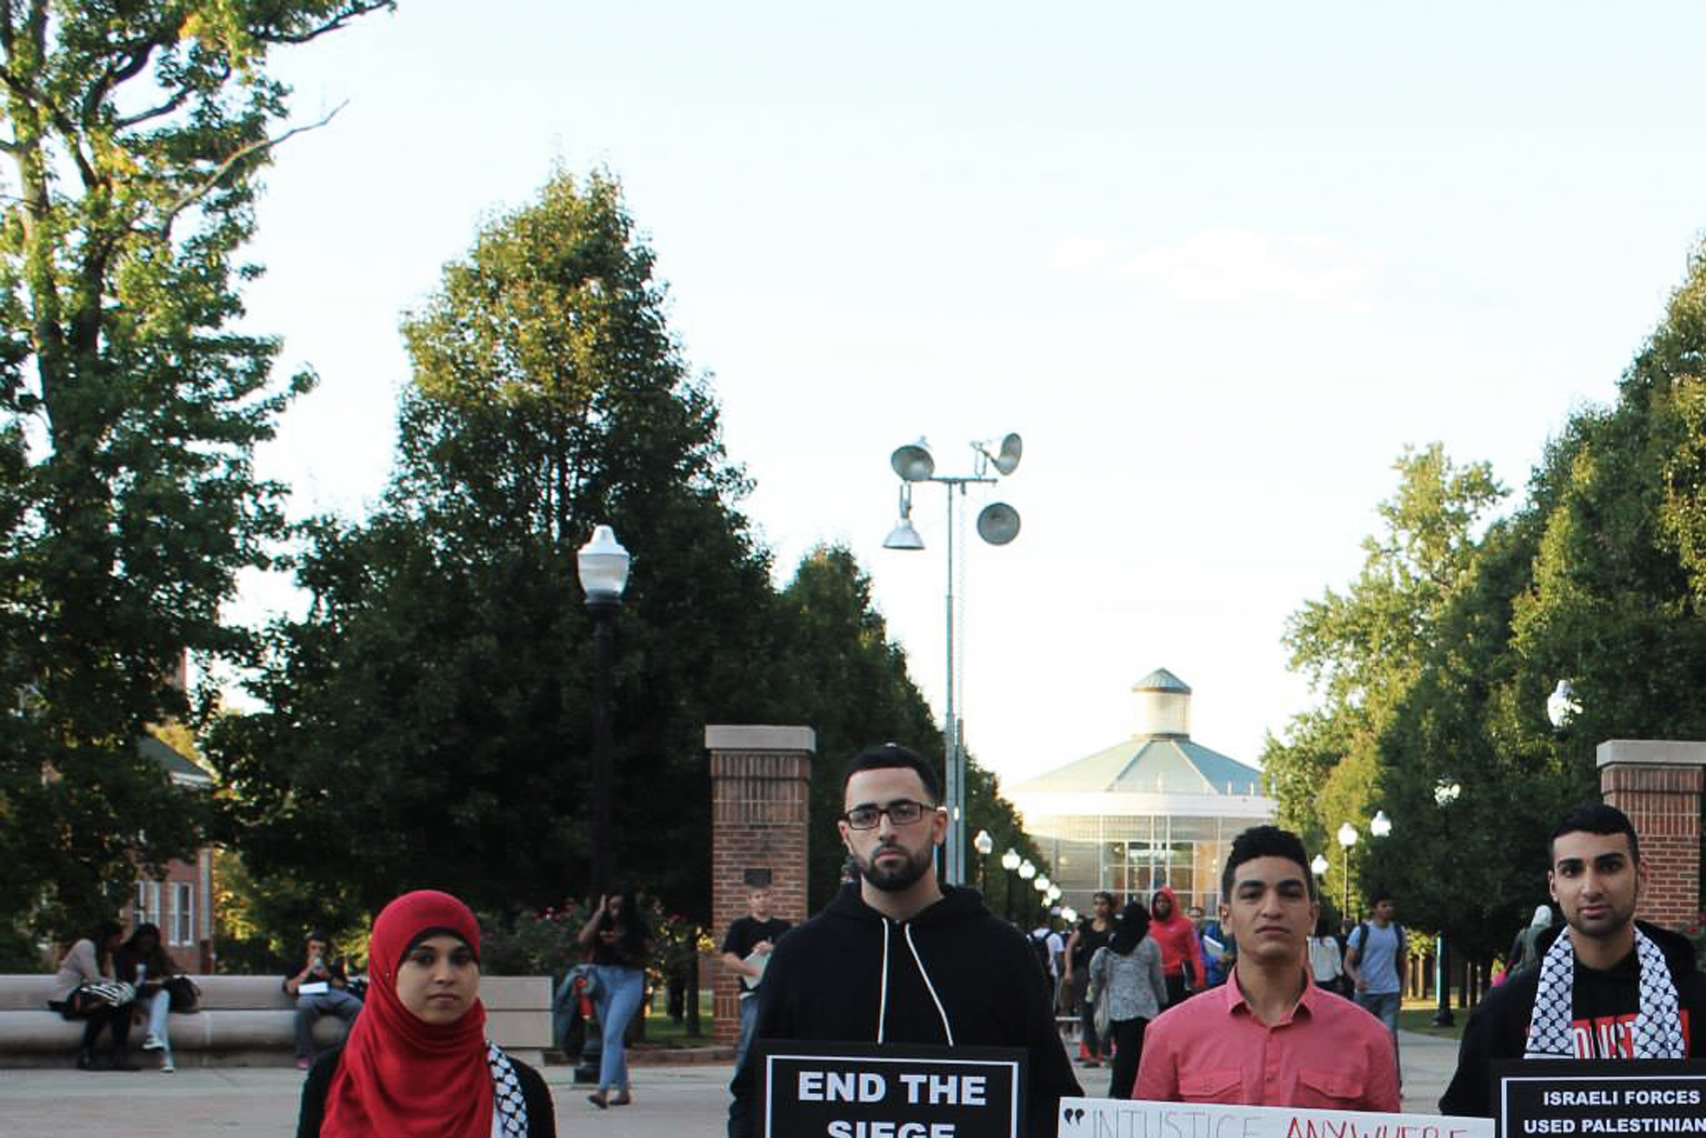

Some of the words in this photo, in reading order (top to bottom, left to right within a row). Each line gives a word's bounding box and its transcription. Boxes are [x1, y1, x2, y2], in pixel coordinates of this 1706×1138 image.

[798, 1071, 886, 1102] END
[900, 1074, 986, 1105] THE
[1544, 1091, 1618, 1105] ISRAELI
[1625, 1090, 1700, 1104] FORCES
[1524, 1119, 1575, 1133] USED
